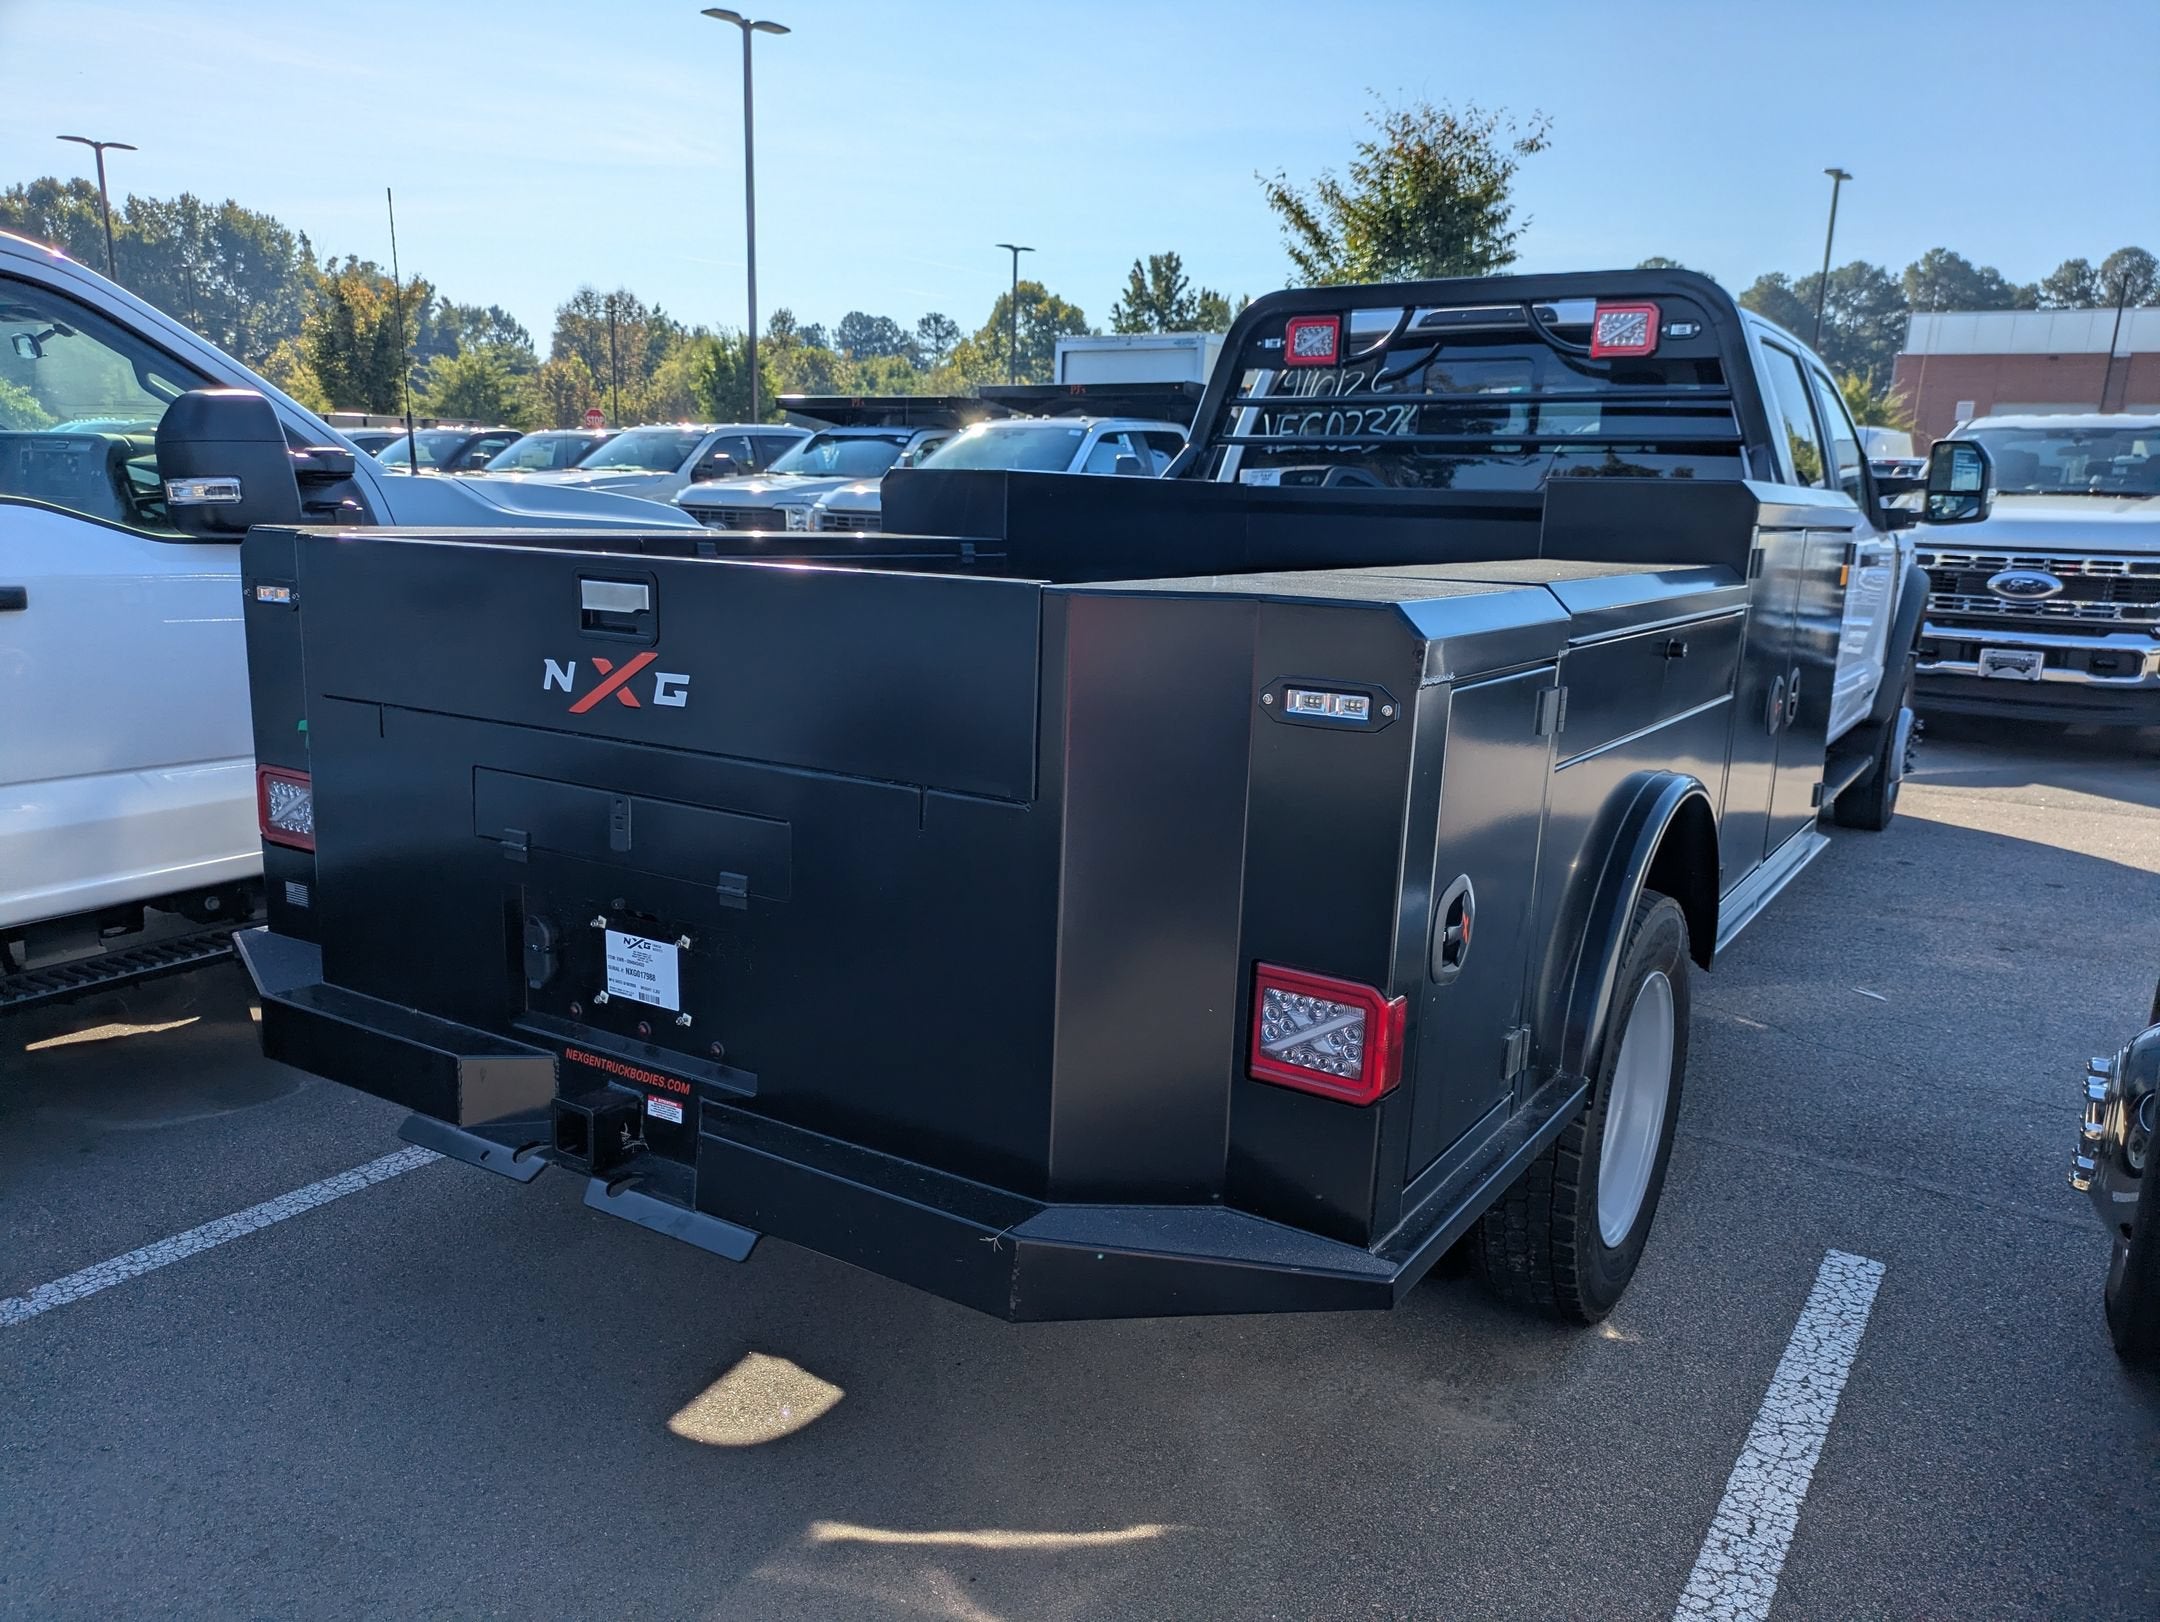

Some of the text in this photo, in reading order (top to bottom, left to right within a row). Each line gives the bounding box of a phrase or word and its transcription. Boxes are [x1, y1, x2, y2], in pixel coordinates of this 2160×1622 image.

[586, 415, 605, 426] STOP
[543, 651, 691, 714] NXG
[623, 937, 652, 950] NXG
[565, 1047, 691, 1095] NEXGENTRUCKBODIES.COM
